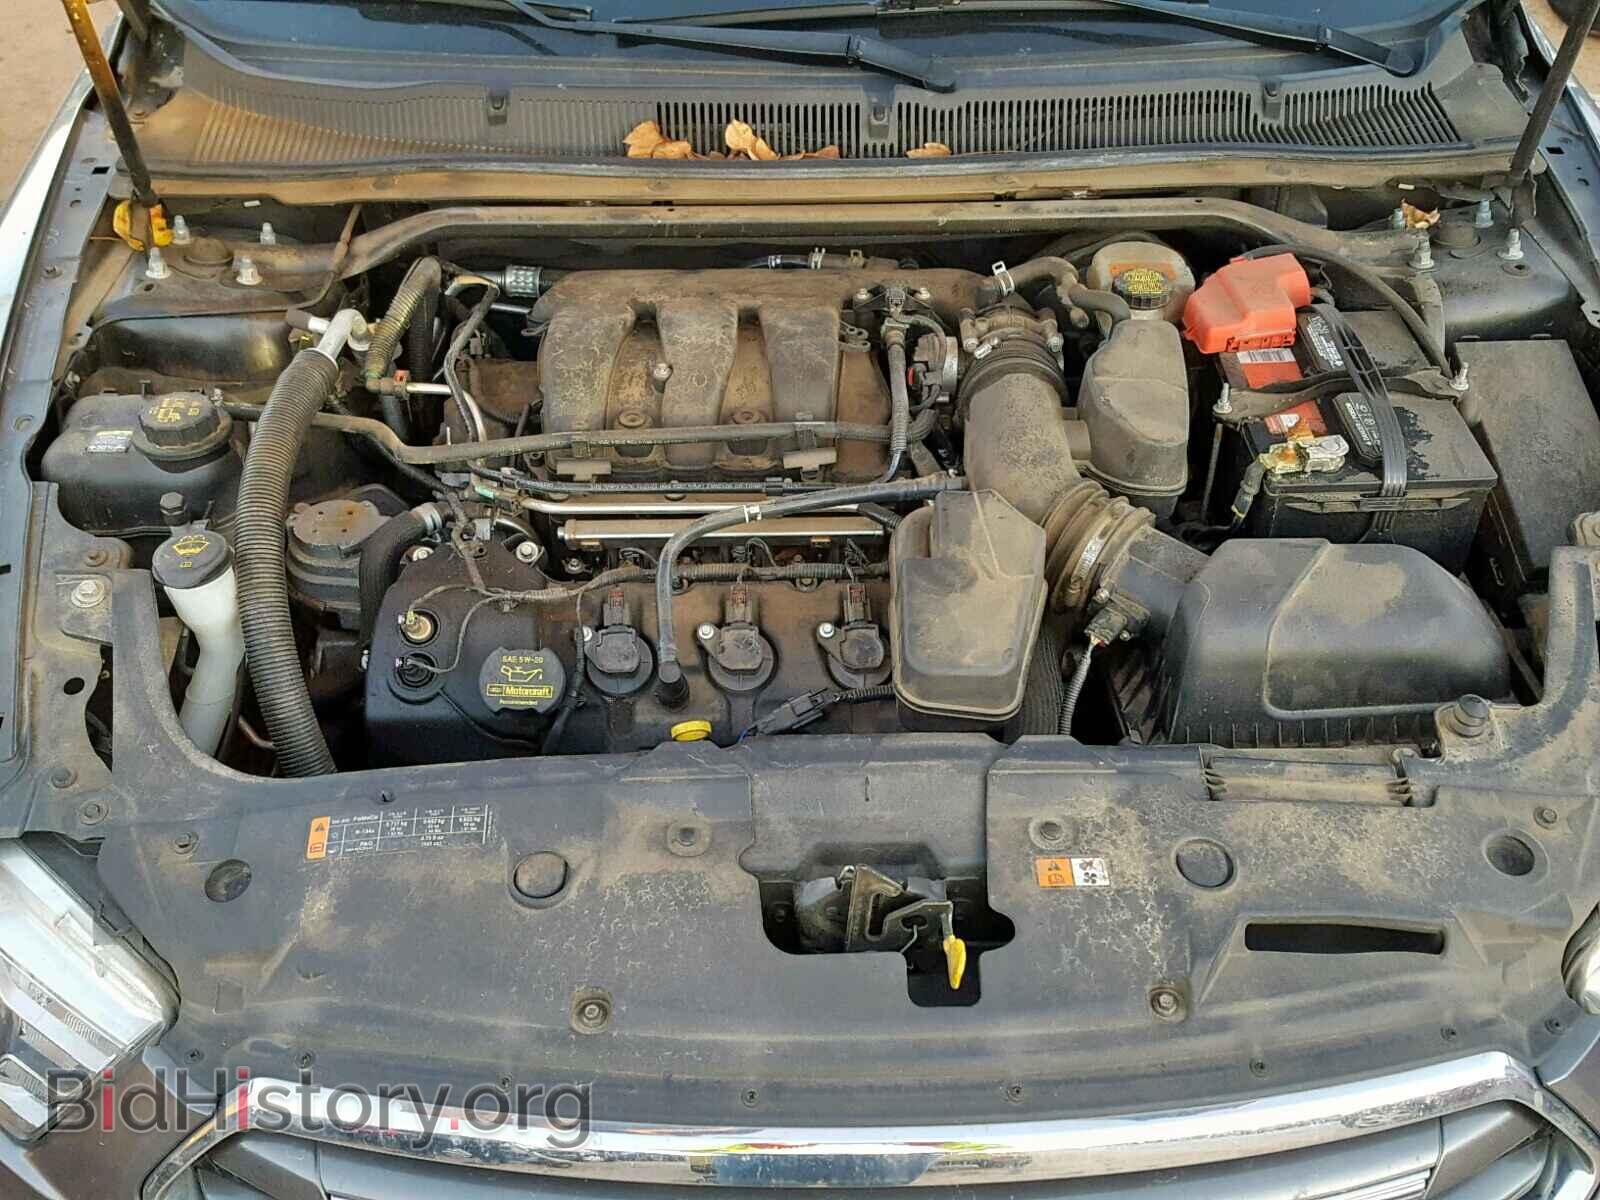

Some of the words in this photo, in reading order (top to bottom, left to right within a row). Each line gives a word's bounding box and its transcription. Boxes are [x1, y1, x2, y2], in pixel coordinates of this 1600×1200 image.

[502, 655, 517, 663] SAE
[519, 655, 544, 664] 5W-20
[505, 686, 550, 696] Motorcraft
